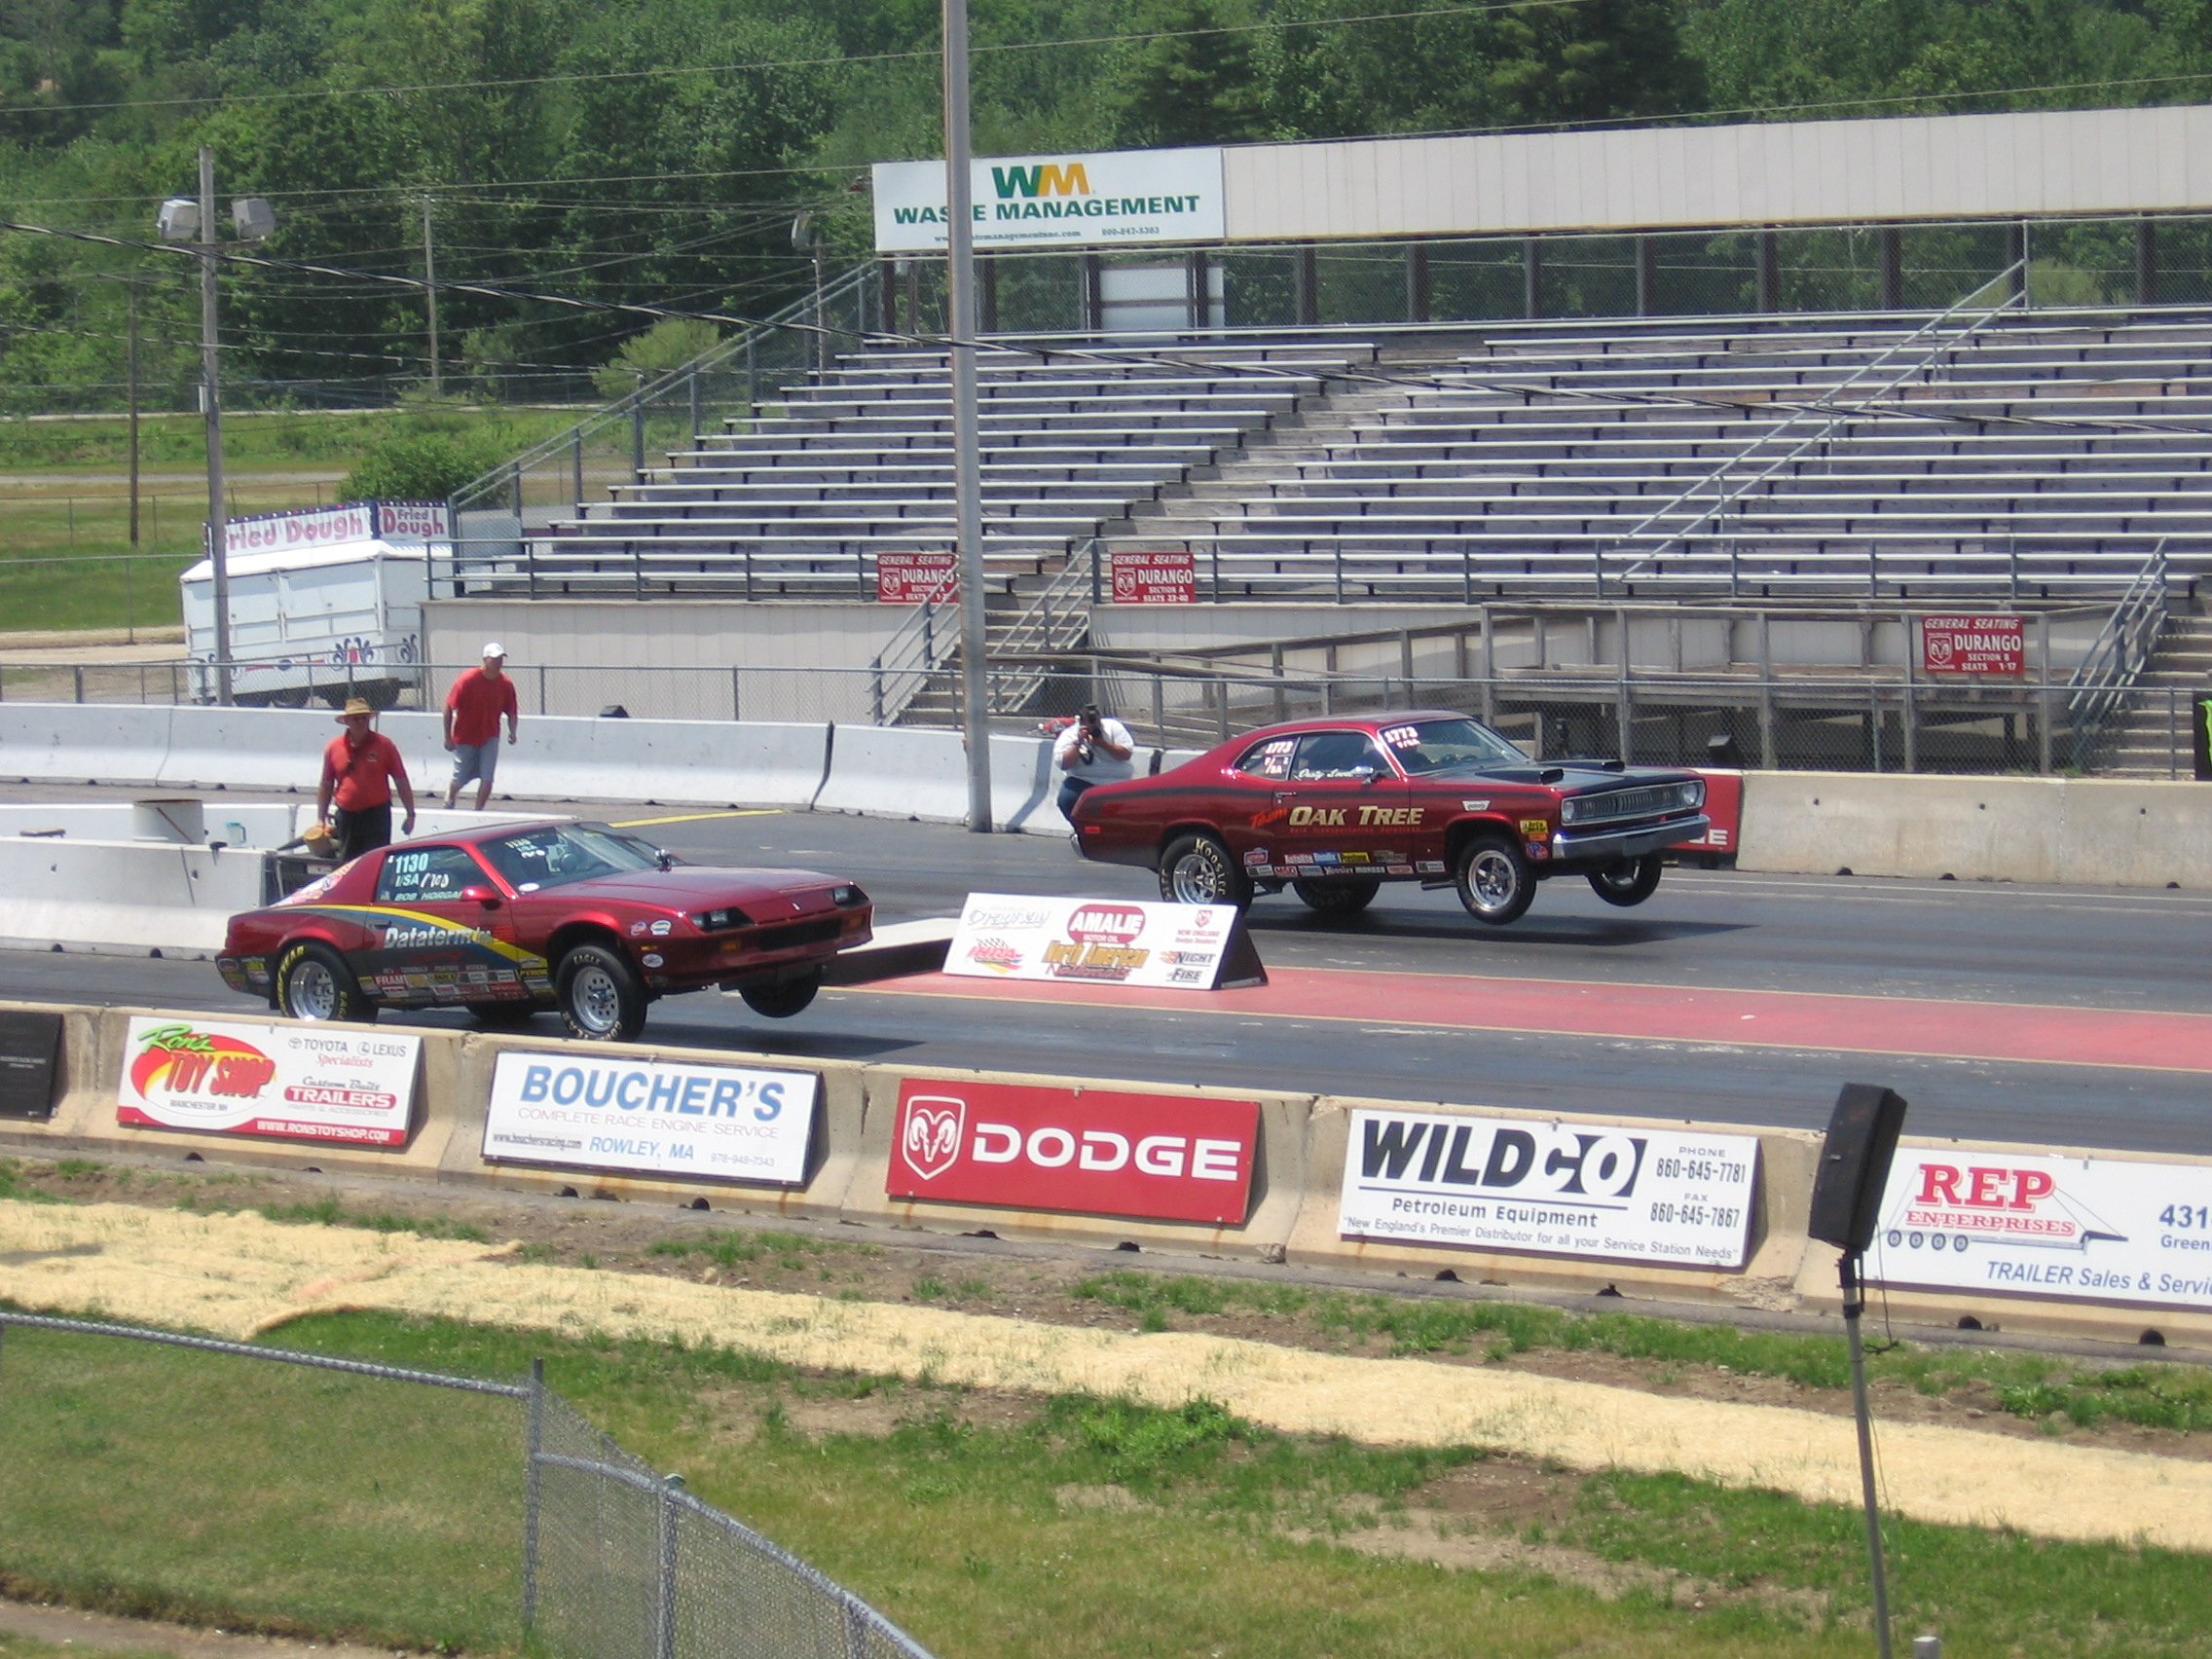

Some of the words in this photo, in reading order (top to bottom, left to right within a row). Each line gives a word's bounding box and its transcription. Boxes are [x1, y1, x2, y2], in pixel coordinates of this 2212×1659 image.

[991, 163, 1090, 199] WM
[894, 204, 986, 225] WASE
[997, 195, 1200, 220] MANAGEMENT
[225, 523, 277, 551] ried
[286, 513, 363, 543] Dough
[383, 508, 445, 536] Dough
[1113, 555, 1150, 565] GENERAL
[1153, 555, 1190, 565] SEATING
[902, 569, 954, 583] DURANGO
[1137, 569, 1193, 584] DURANGO
[1925, 618, 1970, 629] GENERAL
[1973, 618, 2020, 630] SEATING
[1954, 634, 2021, 651] DURANGO
[1968, 652, 2001, 662] SECTION
[1383, 726, 1419, 743] 1773
[1266, 741, 1293, 754] 1773
[1289, 806, 1347, 827] OAK
[1358, 805, 1424, 827] TREE
[394, 853, 428, 874] 1130
[1069, 911, 1144, 934] AMALIE
[1176, 951, 1216, 964] NIGHT
[1173, 968, 1202, 980] FIRE
[304, 1039, 349, 1052] TOYOTA
[372, 1045, 407, 1057] LEXUS
[315, 1053, 374, 1068] Specialists
[165, 1051, 215, 1093] TOY
[302, 1076, 346, 1088] Custom
[350, 1079, 381, 1090] Built
[290, 1088, 391, 1108] TRAILERS
[520, 1065, 786, 1122] BOUCHER'S
[257, 1121, 390, 1142] WWW.RONSTOYSHOP.COM
[518, 1107, 600, 1125] COMPLETE
[605, 1113, 646, 1128] RACE
[651, 1118, 708, 1134] ENGINE
[714, 1123, 779, 1139] SERVICE
[590, 1136, 661, 1159] ROWLEY,
[669, 1143, 694, 1160] MA
[972, 1123, 1242, 1181] DODGE
[1361, 1120, 1647, 1198] WILDCO
[1678, 1146, 1726, 1159] PHONE
[1656, 1158, 1747, 1185] 860-645-7781
[1684, 1192, 1709, 1203] FAX
[1914, 1162, 2056, 1213] REP
[1392, 1198, 1487, 1219] Petroleum
[1496, 1205, 1598, 1228] Equipment
[1650, 1201, 1741, 1229] 860-645-7867
[1904, 1209, 2076, 1237] ENTERPRISES
[2158, 1203, 2212, 1229] 431
[1374, 1218, 1426, 1234] England's
[1430, 1223, 1471, 1237] Premier
[1475, 1227, 1532, 1242] Distributor
[1537, 1232, 1553, 1243] for
[1557, 1234, 1570, 1245] all
[1574, 1237, 1600, 1253] your
[1604, 1236, 1645, 1252] Service
[1650, 1240, 1691, 1256] Station
[2161, 1235, 2212, 1251] Green
[1986, 1260, 2073, 1285] TRAILER
[2079, 1268, 2132, 1289] Sales
[2138, 1272, 2152, 1291] &
